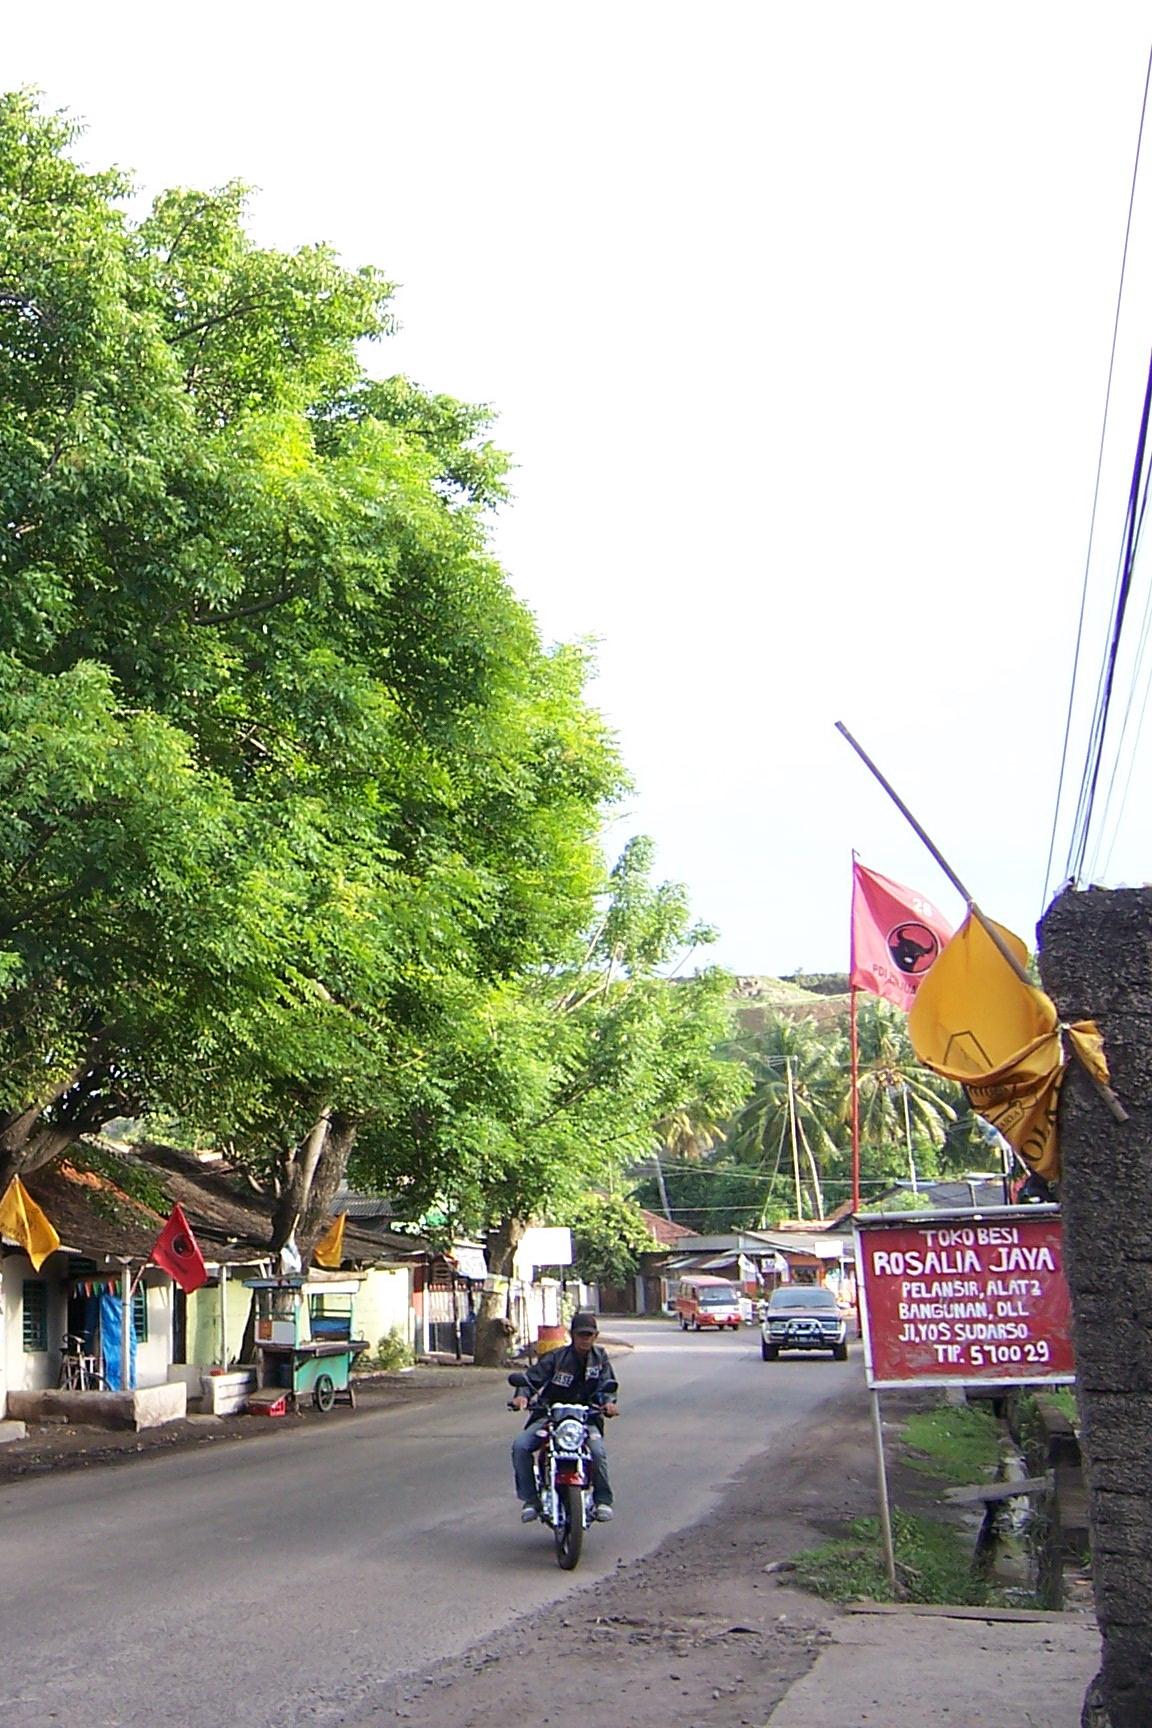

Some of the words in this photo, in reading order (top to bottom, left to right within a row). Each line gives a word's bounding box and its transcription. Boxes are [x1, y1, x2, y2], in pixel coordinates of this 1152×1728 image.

[919, 1228, 974, 1248] TOKO
[978, 1227, 1018, 1245] BESI
[873, 1250, 982, 1276] ROSALIA
[989, 1247, 1054, 1272] JAYA
[901, 1281, 984, 1299] PELANSIR,
[898, 1302, 994, 1320] BANGUNAN,
[997, 1301, 1029, 1317] DLL
[954, 1322, 1028, 1341] SUDARSO
